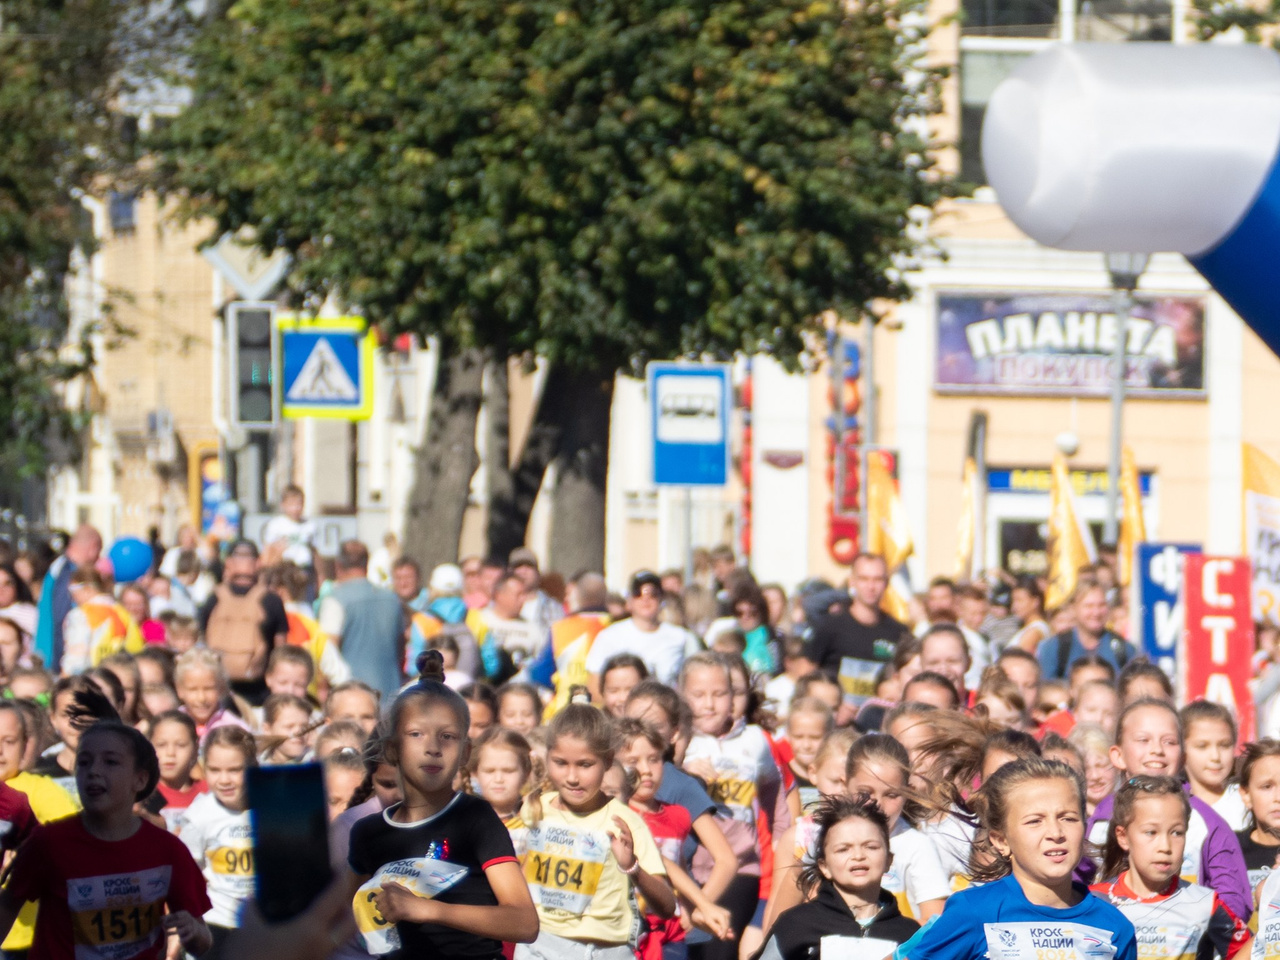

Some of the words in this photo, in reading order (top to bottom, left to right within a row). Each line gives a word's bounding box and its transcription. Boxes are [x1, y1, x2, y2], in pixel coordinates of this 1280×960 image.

[965, 311, 1178, 366] ПЛАНЕТА
[1030, 928, 1063, 938] КРОСС
[1032, 938, 1074, 949] НАЦИИ
